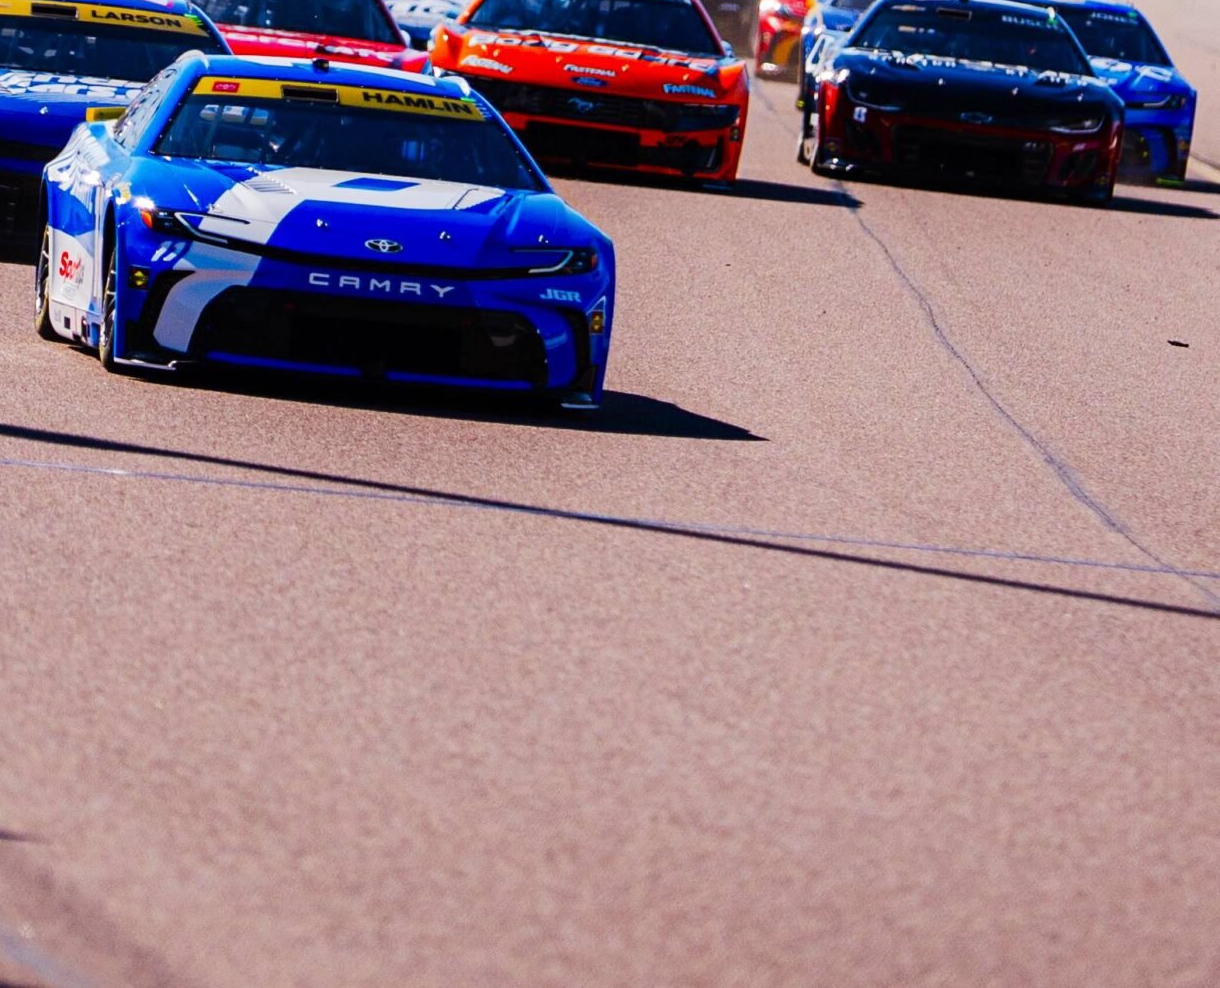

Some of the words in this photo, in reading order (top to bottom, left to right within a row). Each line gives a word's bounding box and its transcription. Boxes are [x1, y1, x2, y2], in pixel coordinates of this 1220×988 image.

[90, 9, 183, 28] LARSON
[362, 91, 473, 115] HAMLIN
[308, 271, 455, 298] CAMRY
[539, 287, 582, 303] JGR
